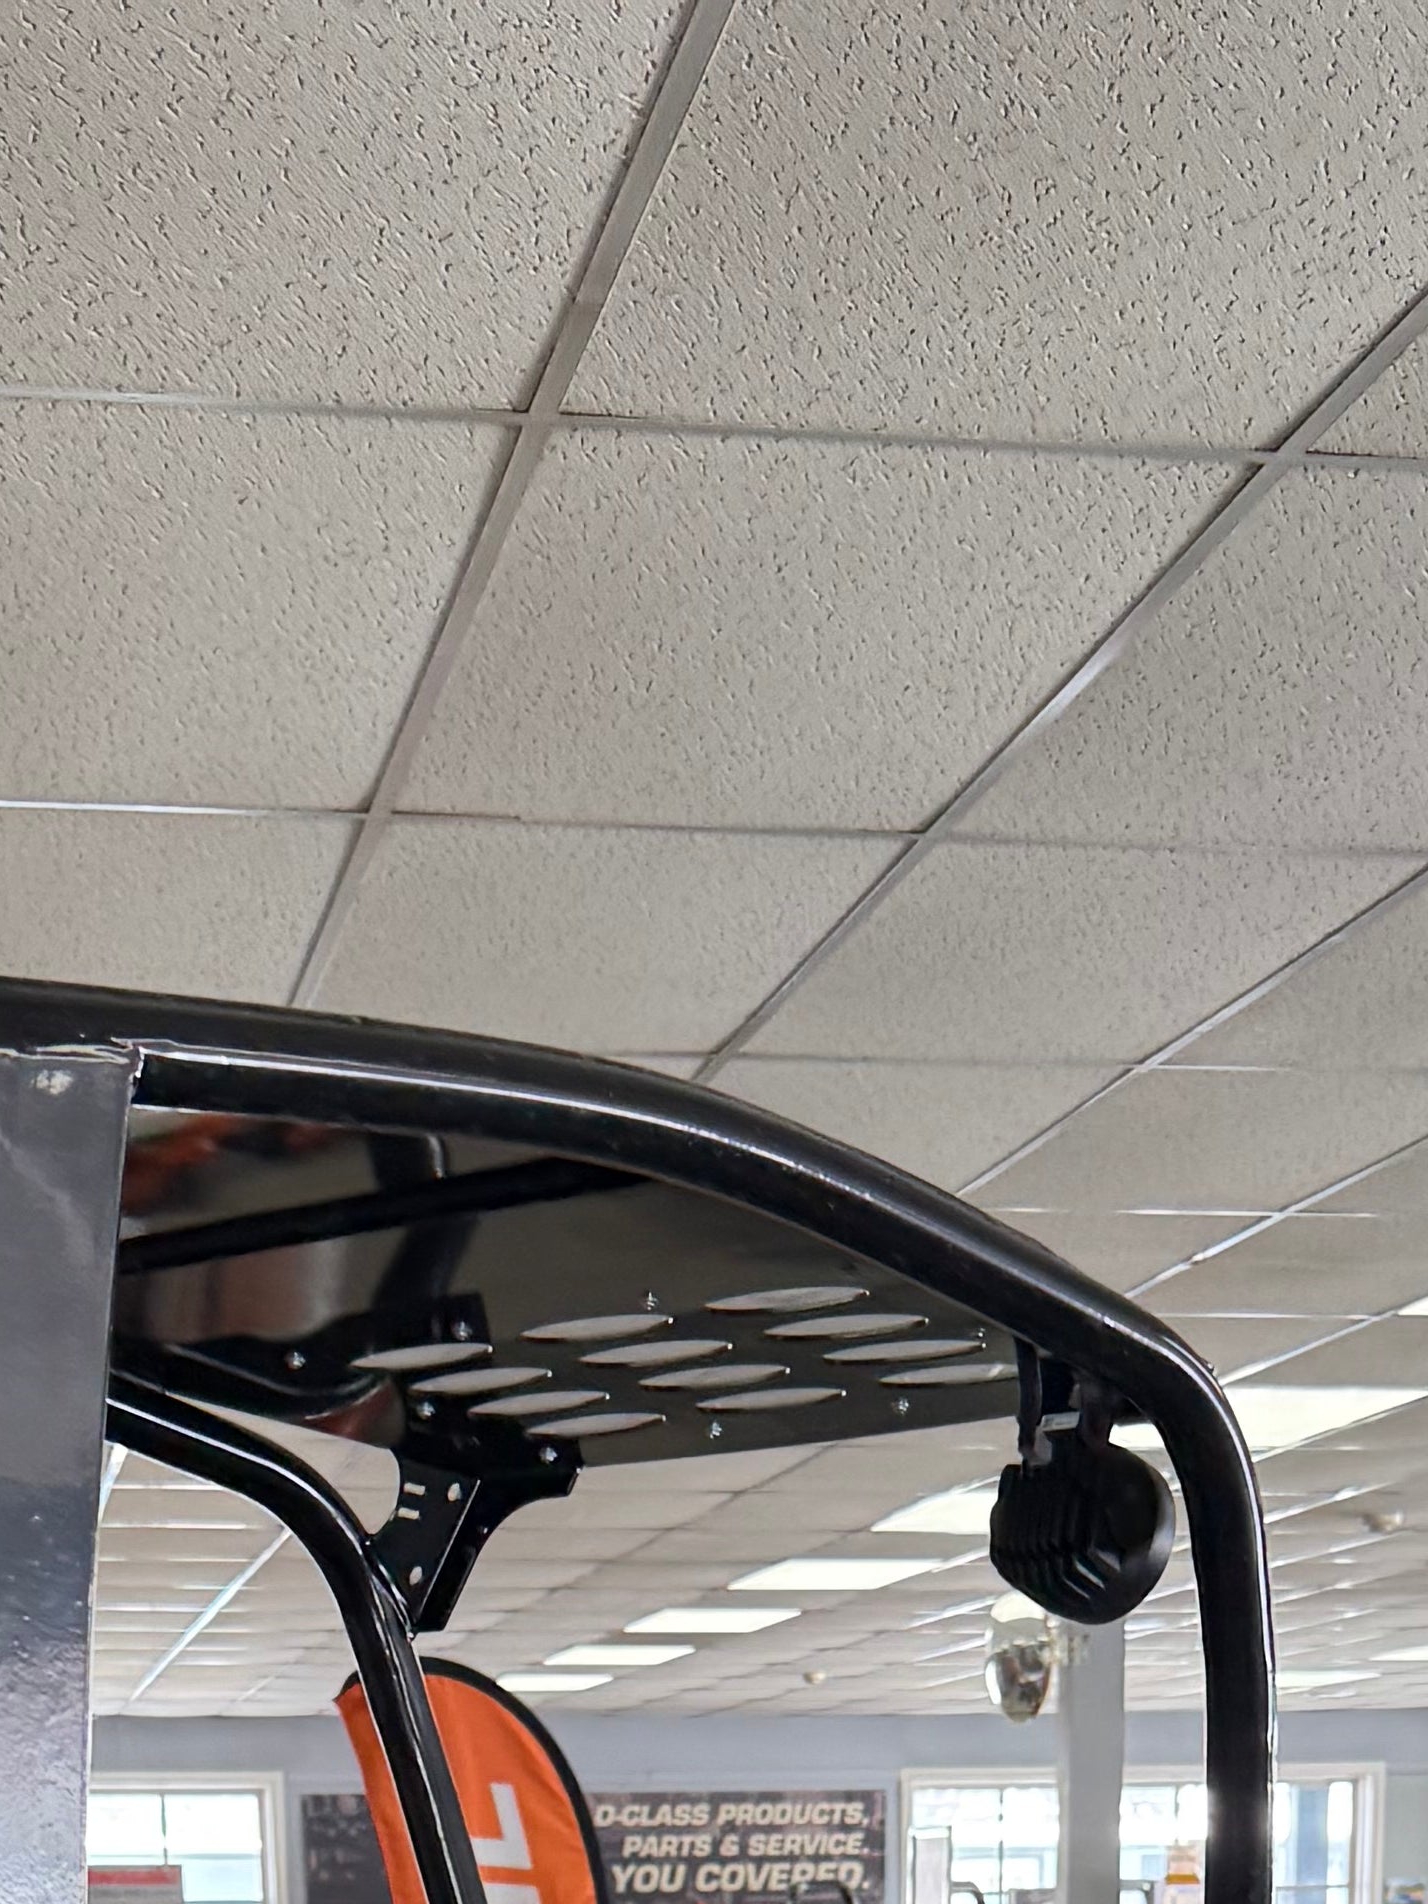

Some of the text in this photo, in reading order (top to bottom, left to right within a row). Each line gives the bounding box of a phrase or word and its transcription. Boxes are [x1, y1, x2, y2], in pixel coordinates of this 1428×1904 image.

[594, 1802, 870, 1827] D-CLASS PRODUCTS,
[622, 1833, 870, 1858] PARTS & SERVICE.
[612, 1863, 686, 1893] YOU
